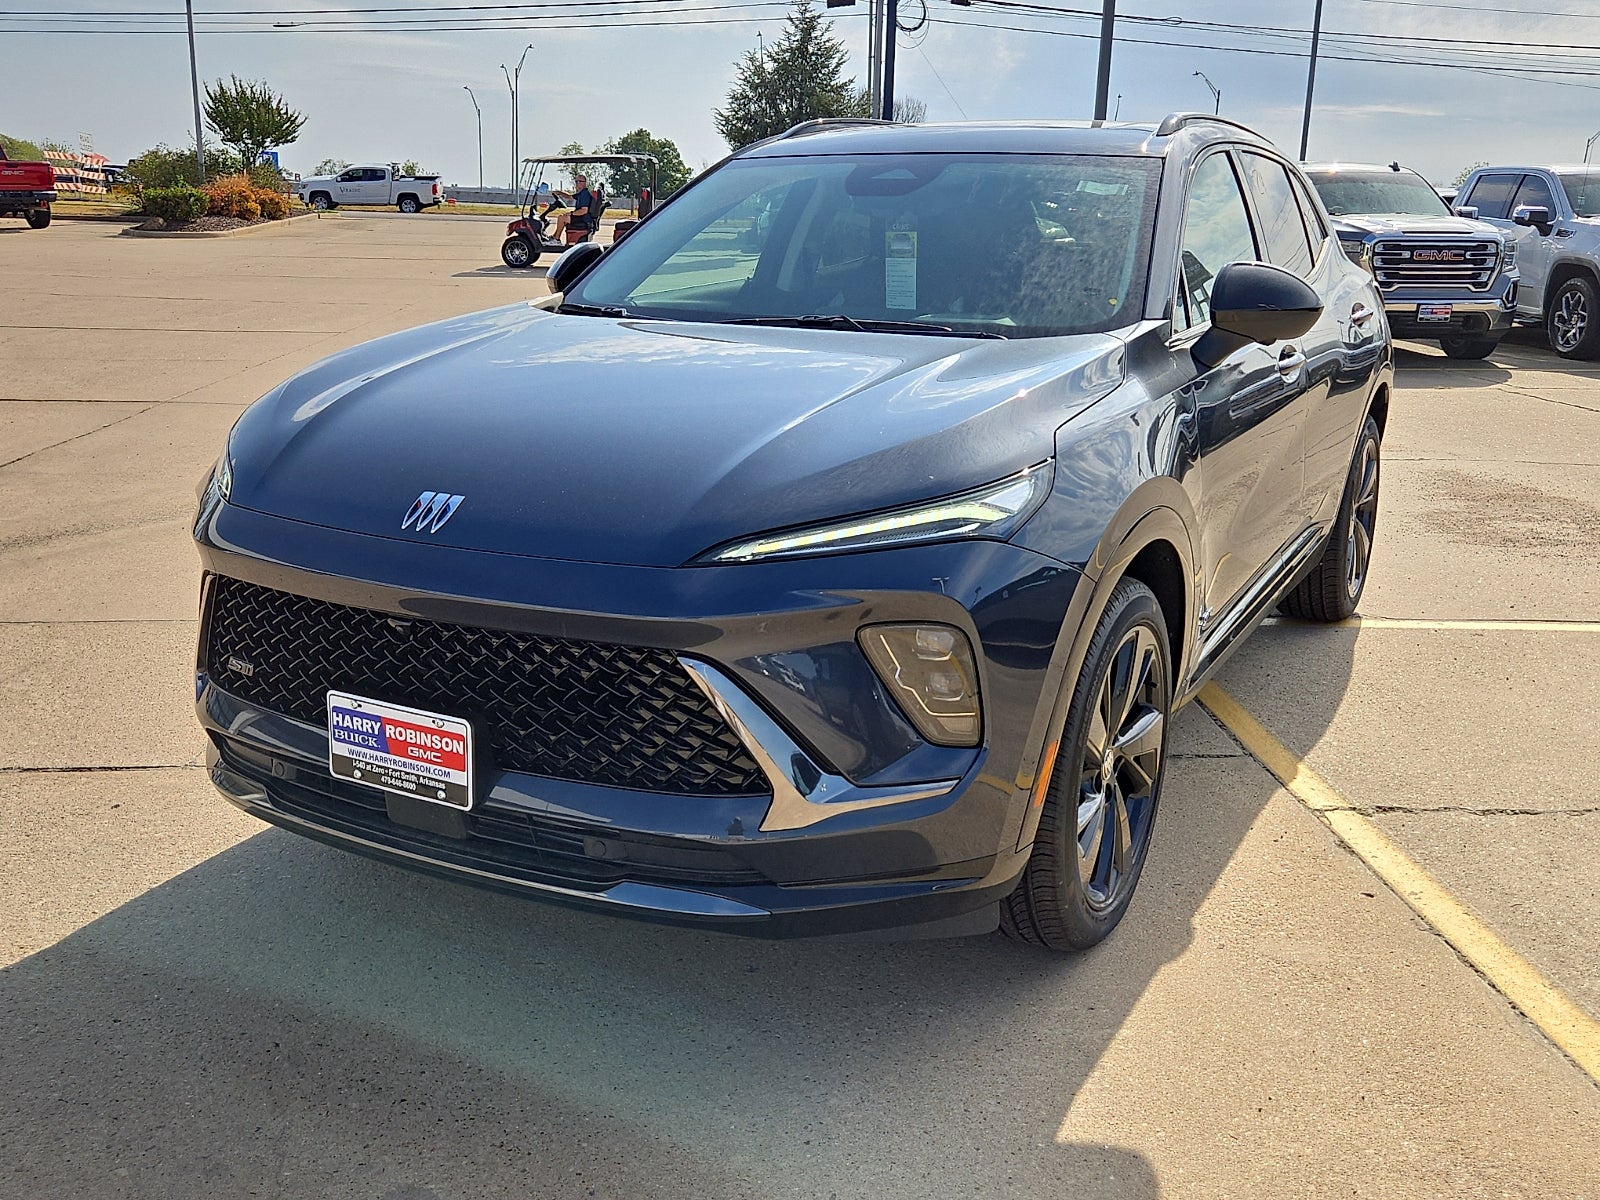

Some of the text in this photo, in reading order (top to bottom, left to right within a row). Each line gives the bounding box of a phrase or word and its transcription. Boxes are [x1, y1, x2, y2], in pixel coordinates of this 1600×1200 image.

[1413, 249, 1465, 261] GMC
[333, 711, 464, 755] HARRY ROBINSON
[334, 728, 378, 748] BUICK
[347, 747, 451, 779] WWW.HARRYROBINSON.COM
[407, 746, 443, 763] GMC
[372, 765, 385, 775] Zero
[419, 777, 446, 790] Arkansas
